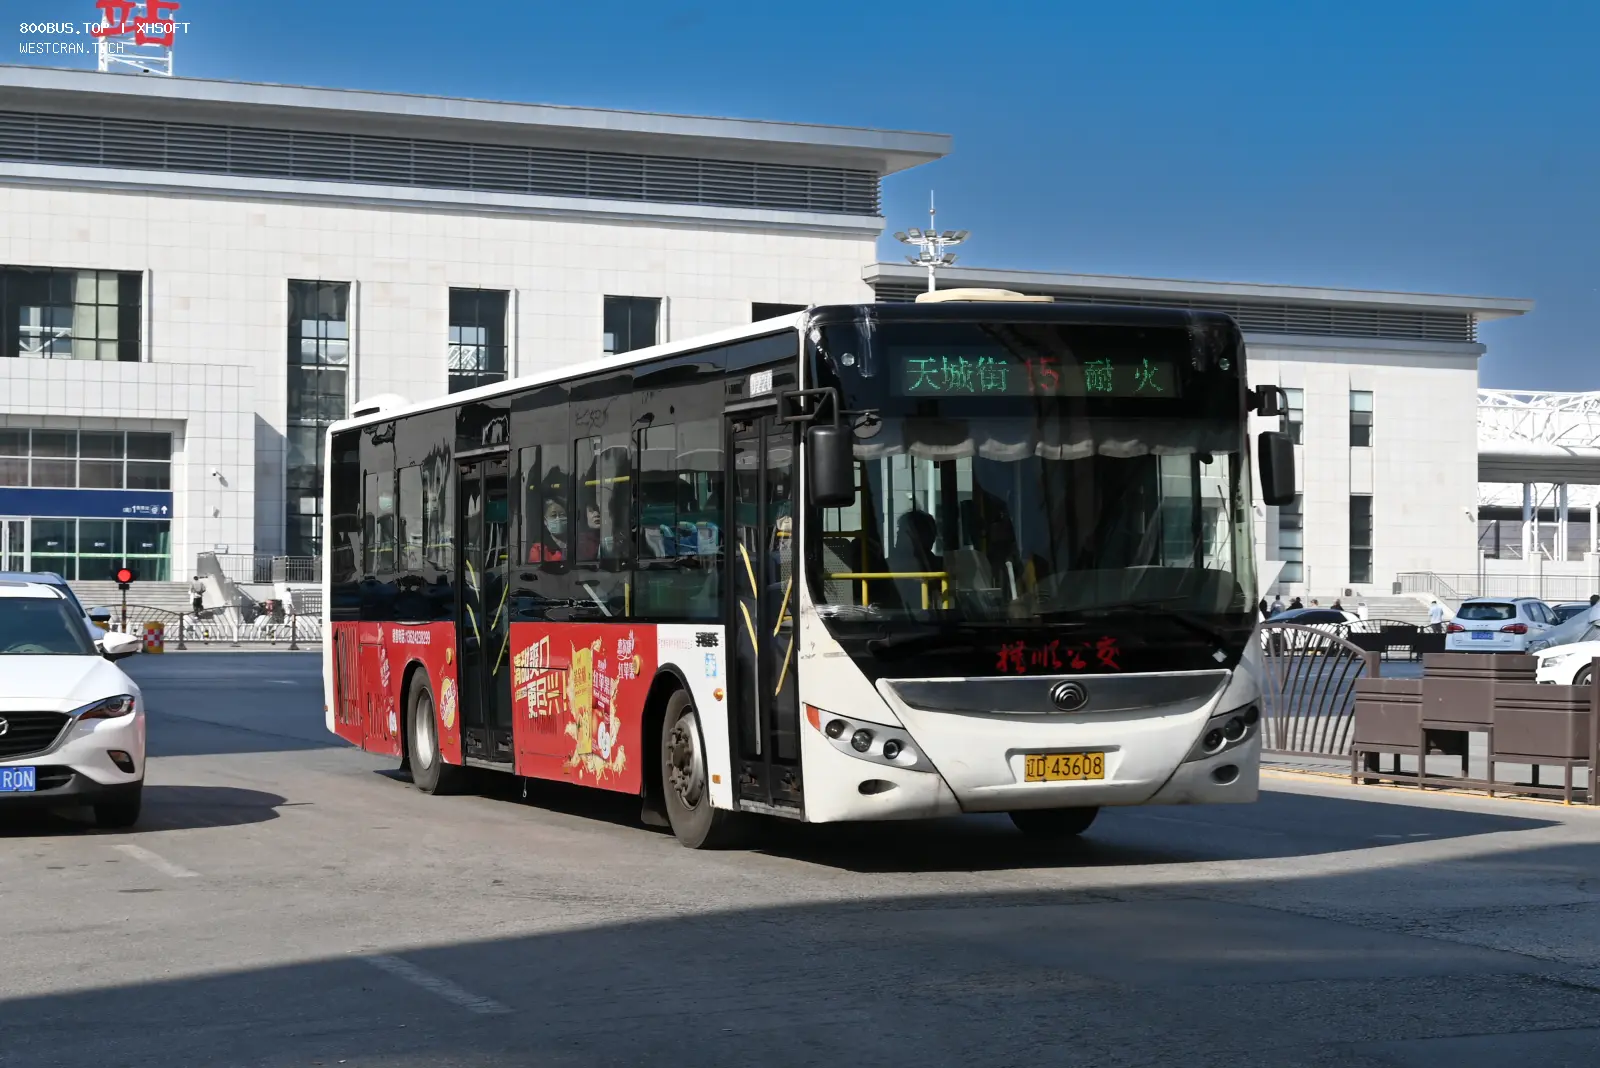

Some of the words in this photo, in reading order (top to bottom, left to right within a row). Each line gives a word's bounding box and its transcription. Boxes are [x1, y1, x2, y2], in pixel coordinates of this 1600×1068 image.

[91, 0, 181, 46] 站
[907, 356, 1009, 392] 天城街
[1026, 357, 1059, 391] 15
